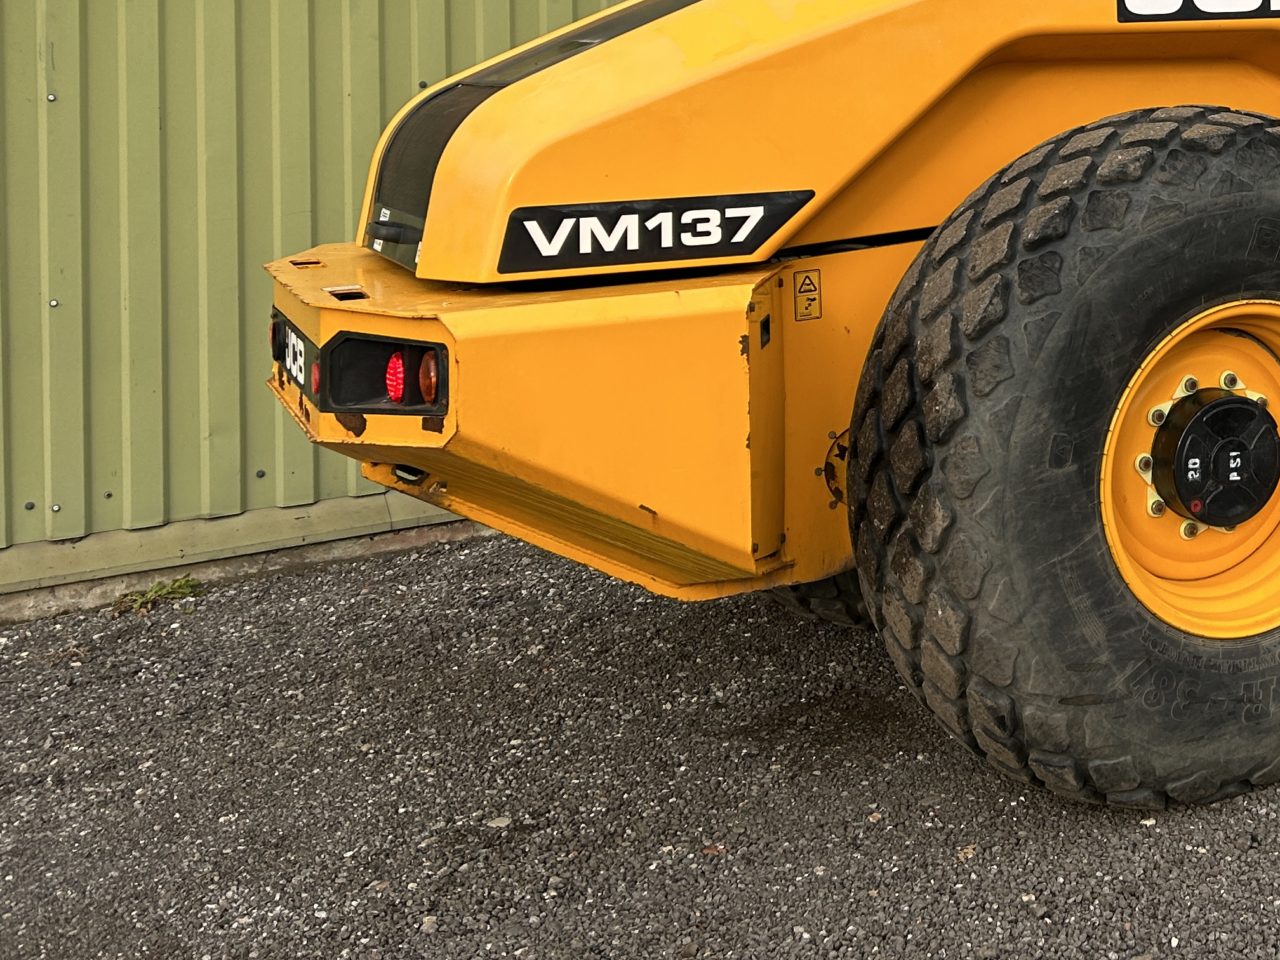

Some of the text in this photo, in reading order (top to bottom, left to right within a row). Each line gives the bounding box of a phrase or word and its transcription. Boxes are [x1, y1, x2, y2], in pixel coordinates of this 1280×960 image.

[523, 205, 766, 258] VM137
[285, 324, 305, 385] JCB
[1229, 451, 1241, 481] PSI
